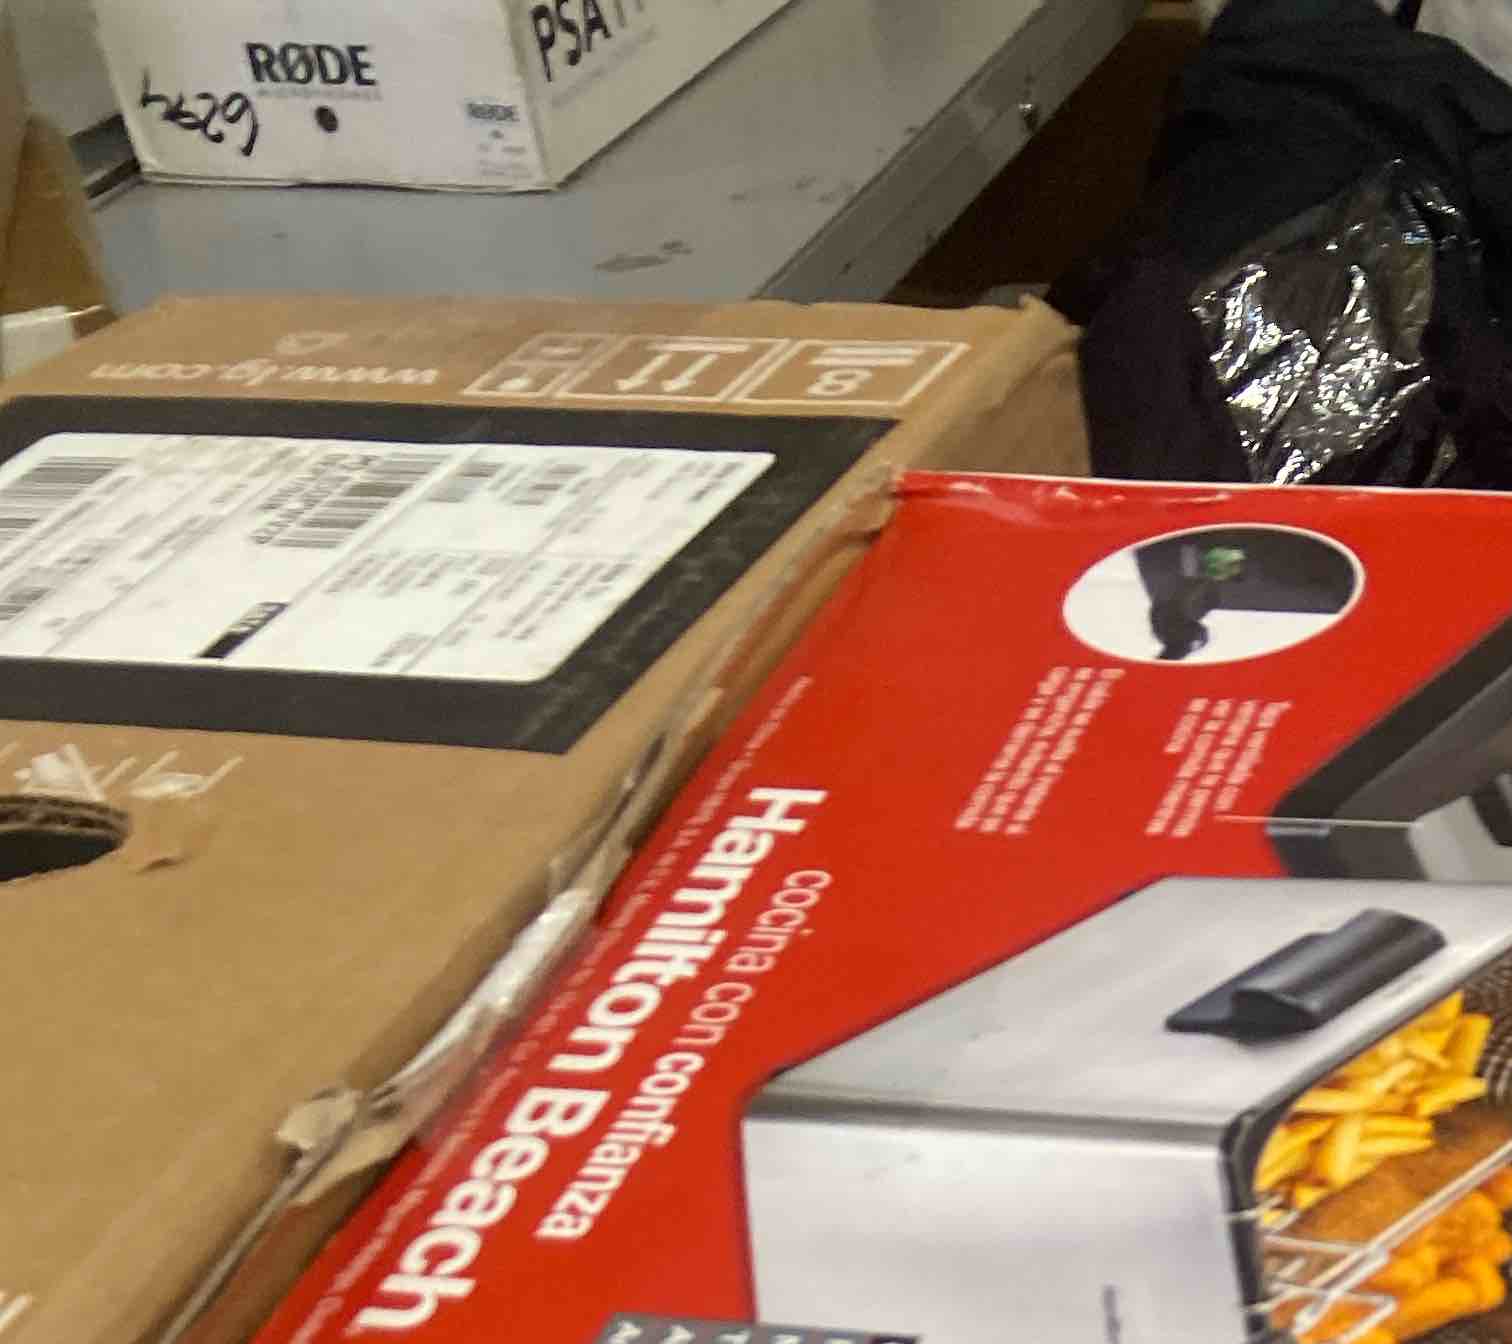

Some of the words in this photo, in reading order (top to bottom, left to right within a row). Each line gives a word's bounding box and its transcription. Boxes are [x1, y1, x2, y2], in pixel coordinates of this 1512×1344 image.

[246, 43, 377, 87] RØDE
[88, 358, 440, 394] www.lg.com
[806, 367, 872, 397] 8
[553, 788, 822, 1071] Hamilton
[725, 869, 831, 973] cocina
[673, 981, 753, 1046] con
[539, 1052, 702, 1238] confianza
[358, 1087, 606, 1328] Beach
